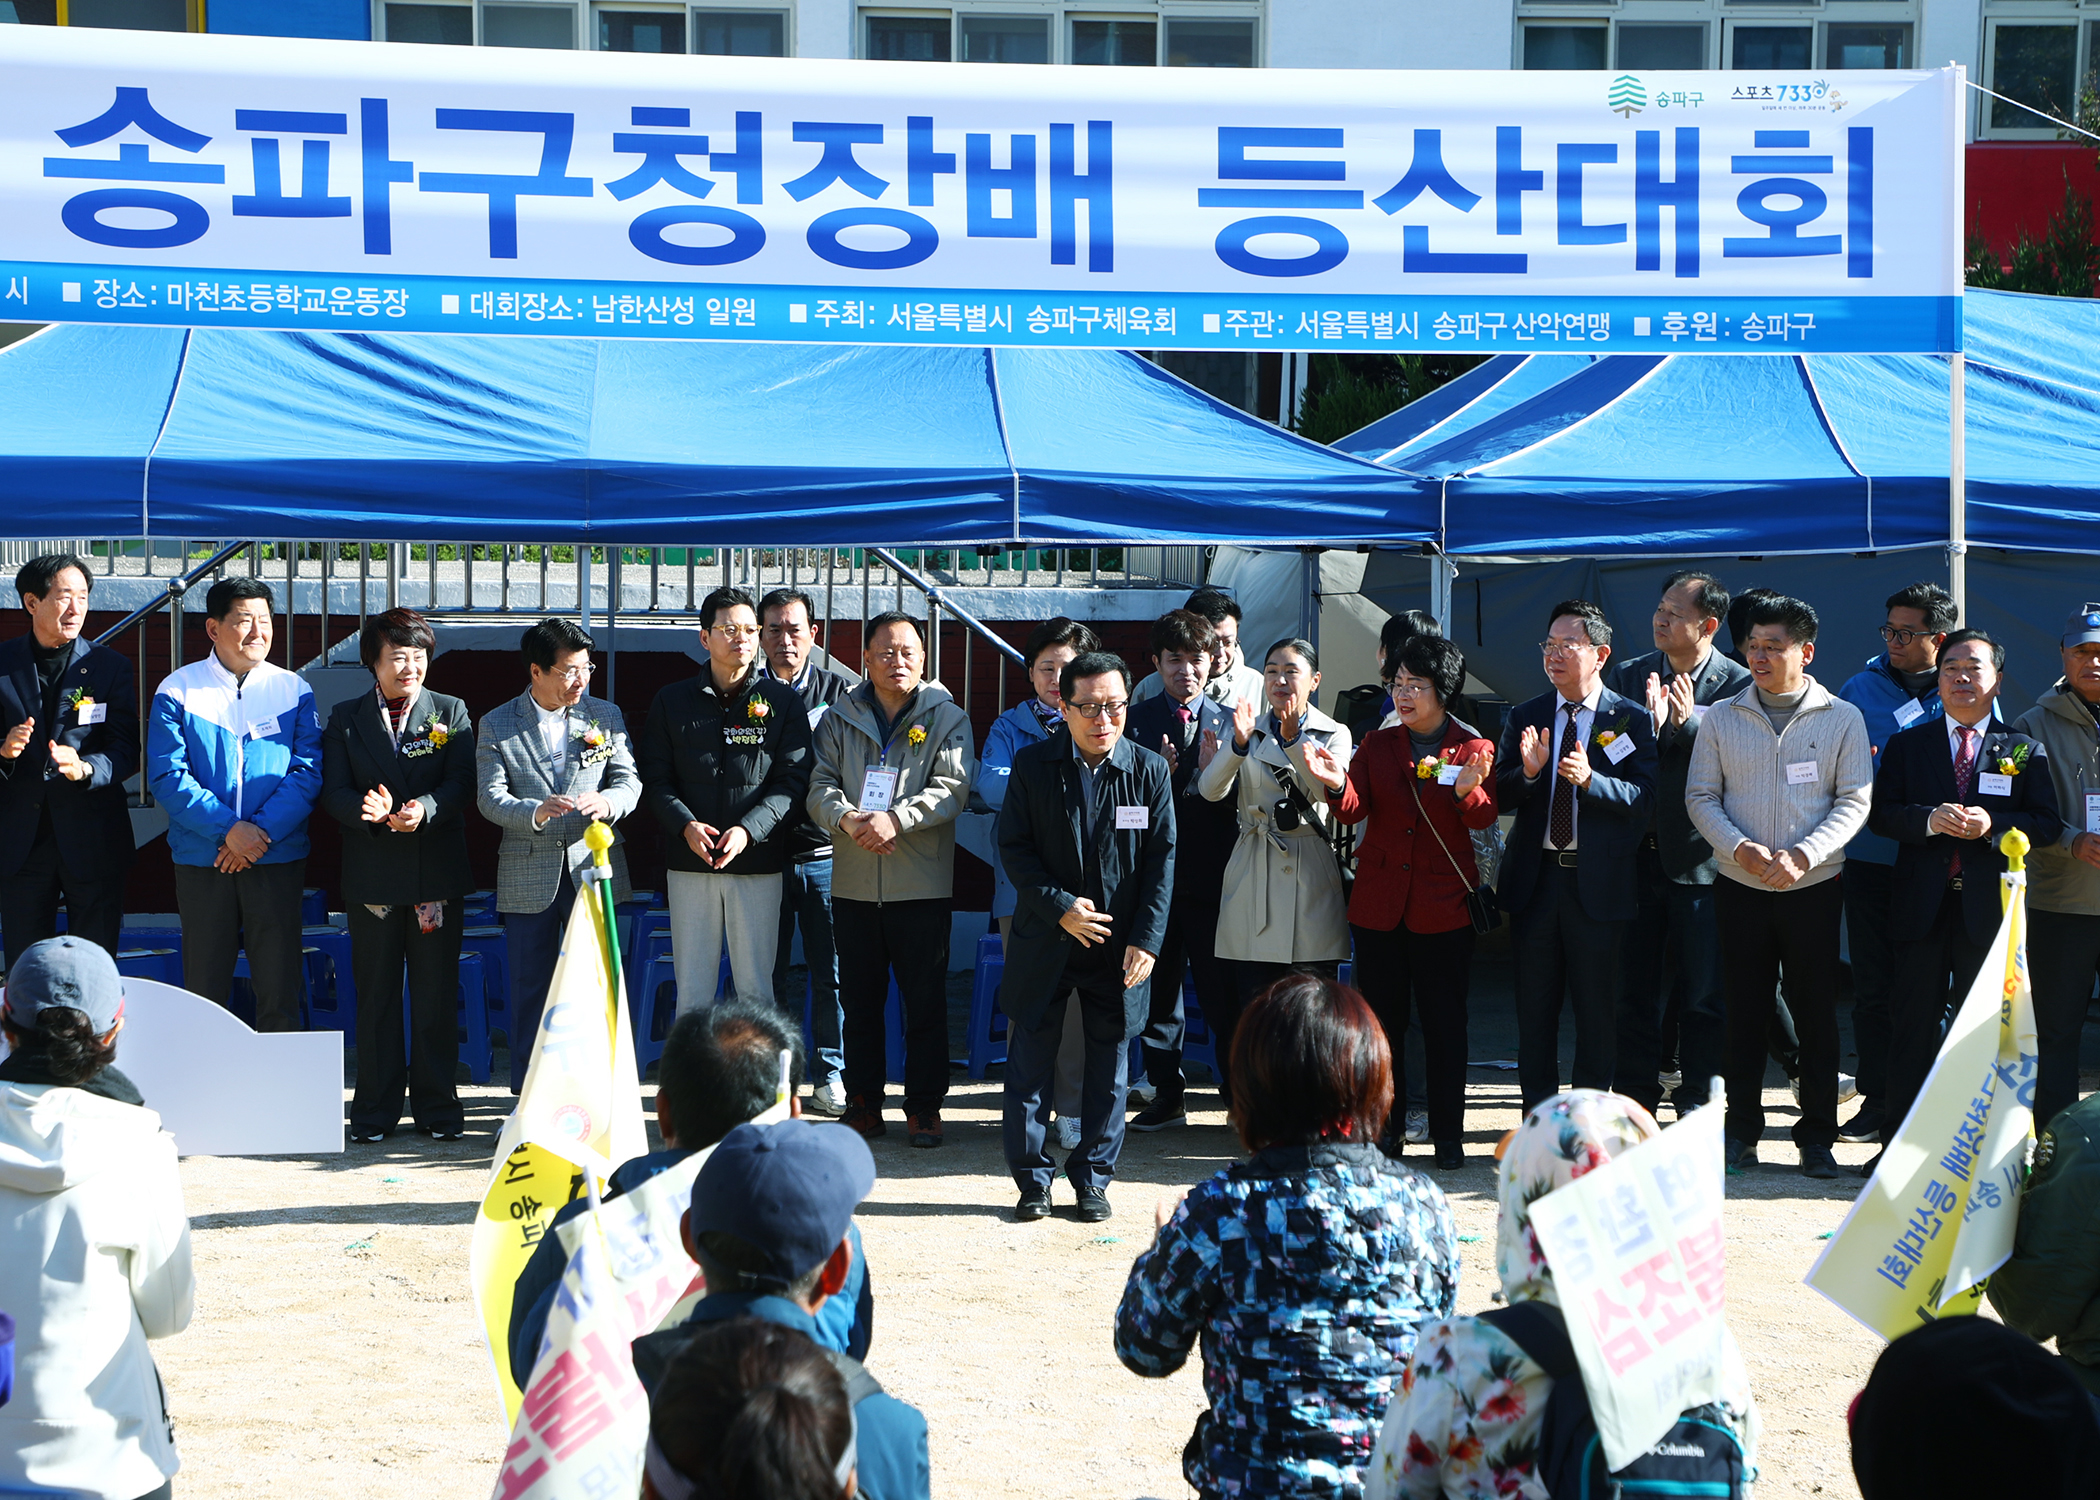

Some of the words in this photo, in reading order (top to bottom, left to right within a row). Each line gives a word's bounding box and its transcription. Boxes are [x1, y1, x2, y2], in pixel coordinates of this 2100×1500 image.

[1655, 91, 1705, 109] 송파구
[1731, 85, 1774, 100] 스포츠
[43, 86, 1114, 272] 송파구청장배
[1198, 126, 1874, 278] 등산대회
[5, 276, 28, 305] 시
[92, 278, 157, 309] 장소:
[167, 281, 410, 318] 마천초등학교운동장
[470, 291, 583, 322] 대회장소:
[592, 295, 694, 326] 남한산성
[705, 298, 756, 327] 일원
[814, 300, 875, 329] 주최:
[886, 303, 1012, 334] 서울특별시
[1026, 305, 1177, 336] 송파구체육회
[1224, 310, 1284, 338] 주관:
[1295, 310, 1419, 340] 서울특별시
[1511, 312, 1610, 342] 산악연맹
[1741, 312, 1816, 342] 송파구
[1656, 1441, 1706, 1458] Columbia
